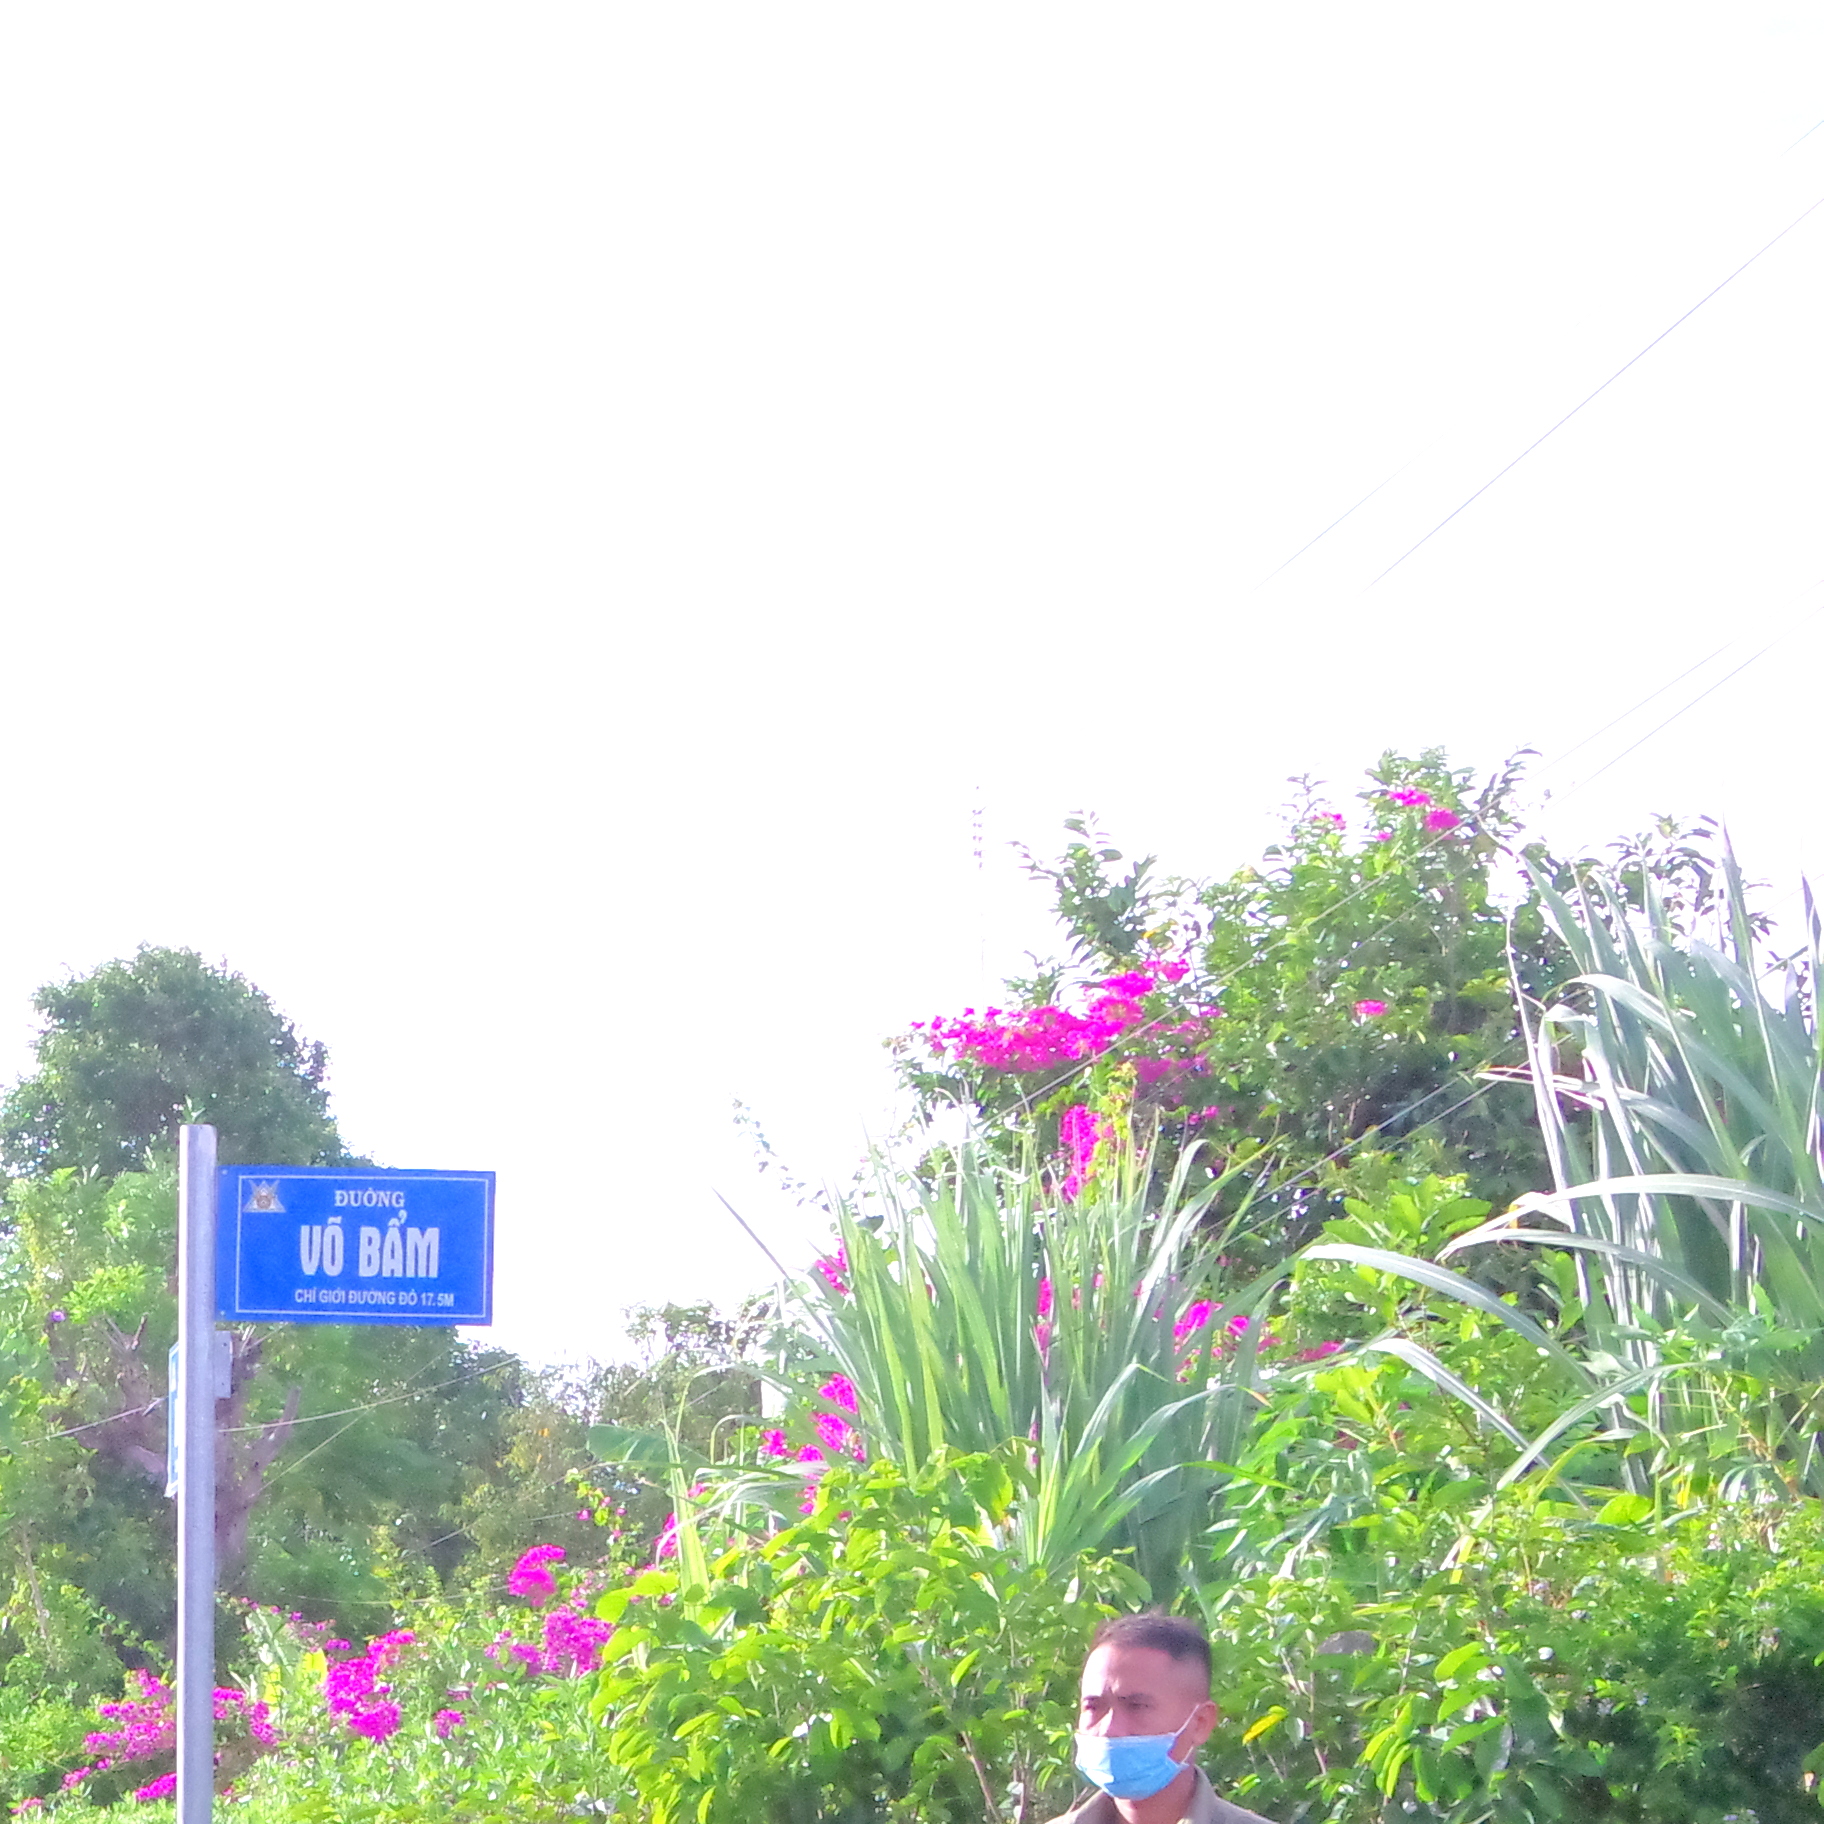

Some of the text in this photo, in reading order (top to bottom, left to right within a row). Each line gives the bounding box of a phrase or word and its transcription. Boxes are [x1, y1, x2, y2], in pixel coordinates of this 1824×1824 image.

[300, 1210, 440, 1279] VÕ BẨM
[421, 1292, 454, 1307] 17.5M
